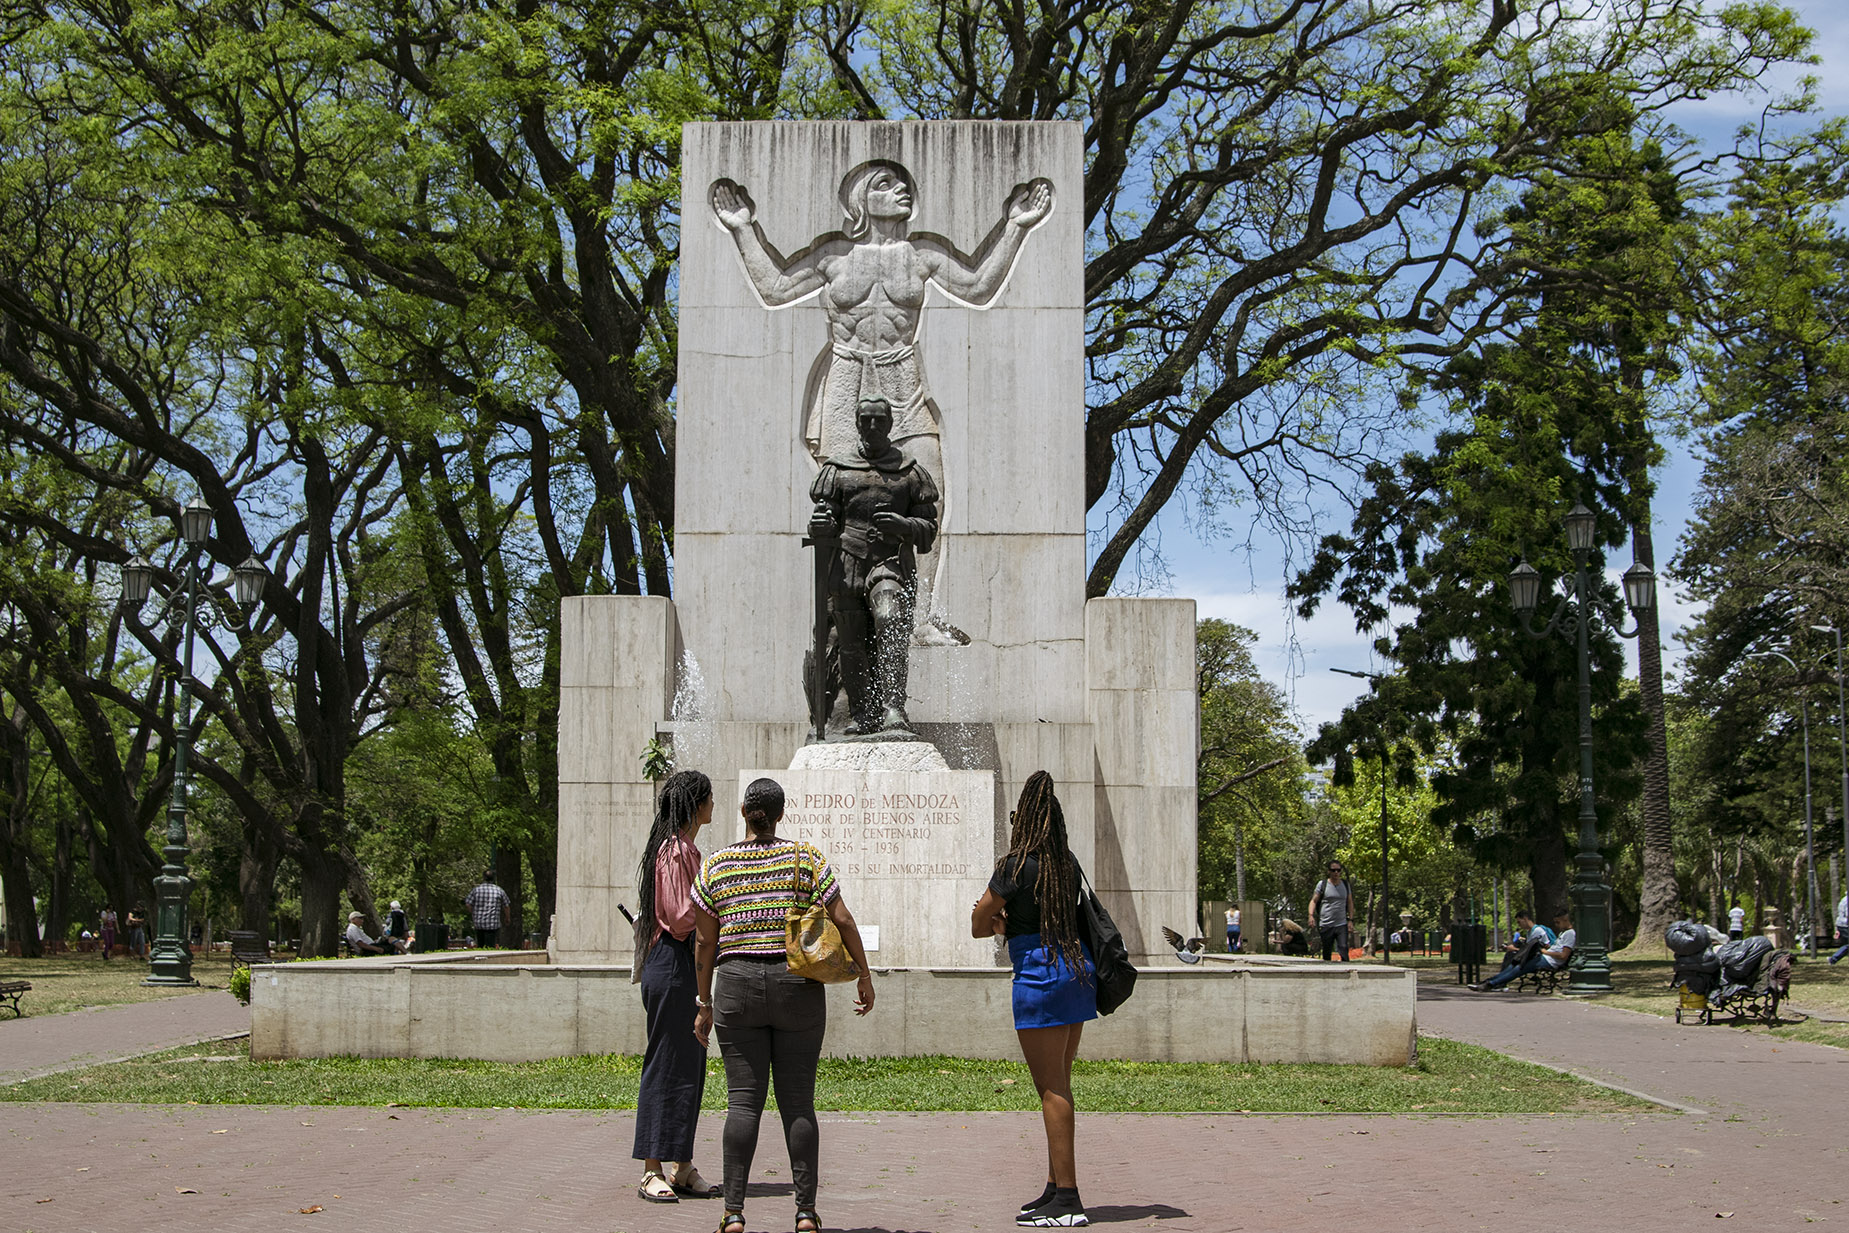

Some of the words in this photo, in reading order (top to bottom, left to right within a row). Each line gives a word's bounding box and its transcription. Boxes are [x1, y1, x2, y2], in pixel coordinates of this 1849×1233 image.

[861, 782, 869, 792] A
[804, 794, 855, 810] PEDRO
[861, 798, 876, 810] DE
[882, 794, 960, 810] MENDOZA
[779, 814, 832, 825] NDADOR
[840, 814, 854, 825] DE
[863, 812, 915, 825] BUENOS
[922, 812, 961, 825] AIRES
[799, 828, 813, 839] EN
[821, 828, 835, 839] SU
[843, 828, 855, 839] IV
[829, 841, 853, 854] 1536
[875, 841, 900, 854] 1936
[848, 863, 860, 874] ES
[867, 863, 881, 874] SU
